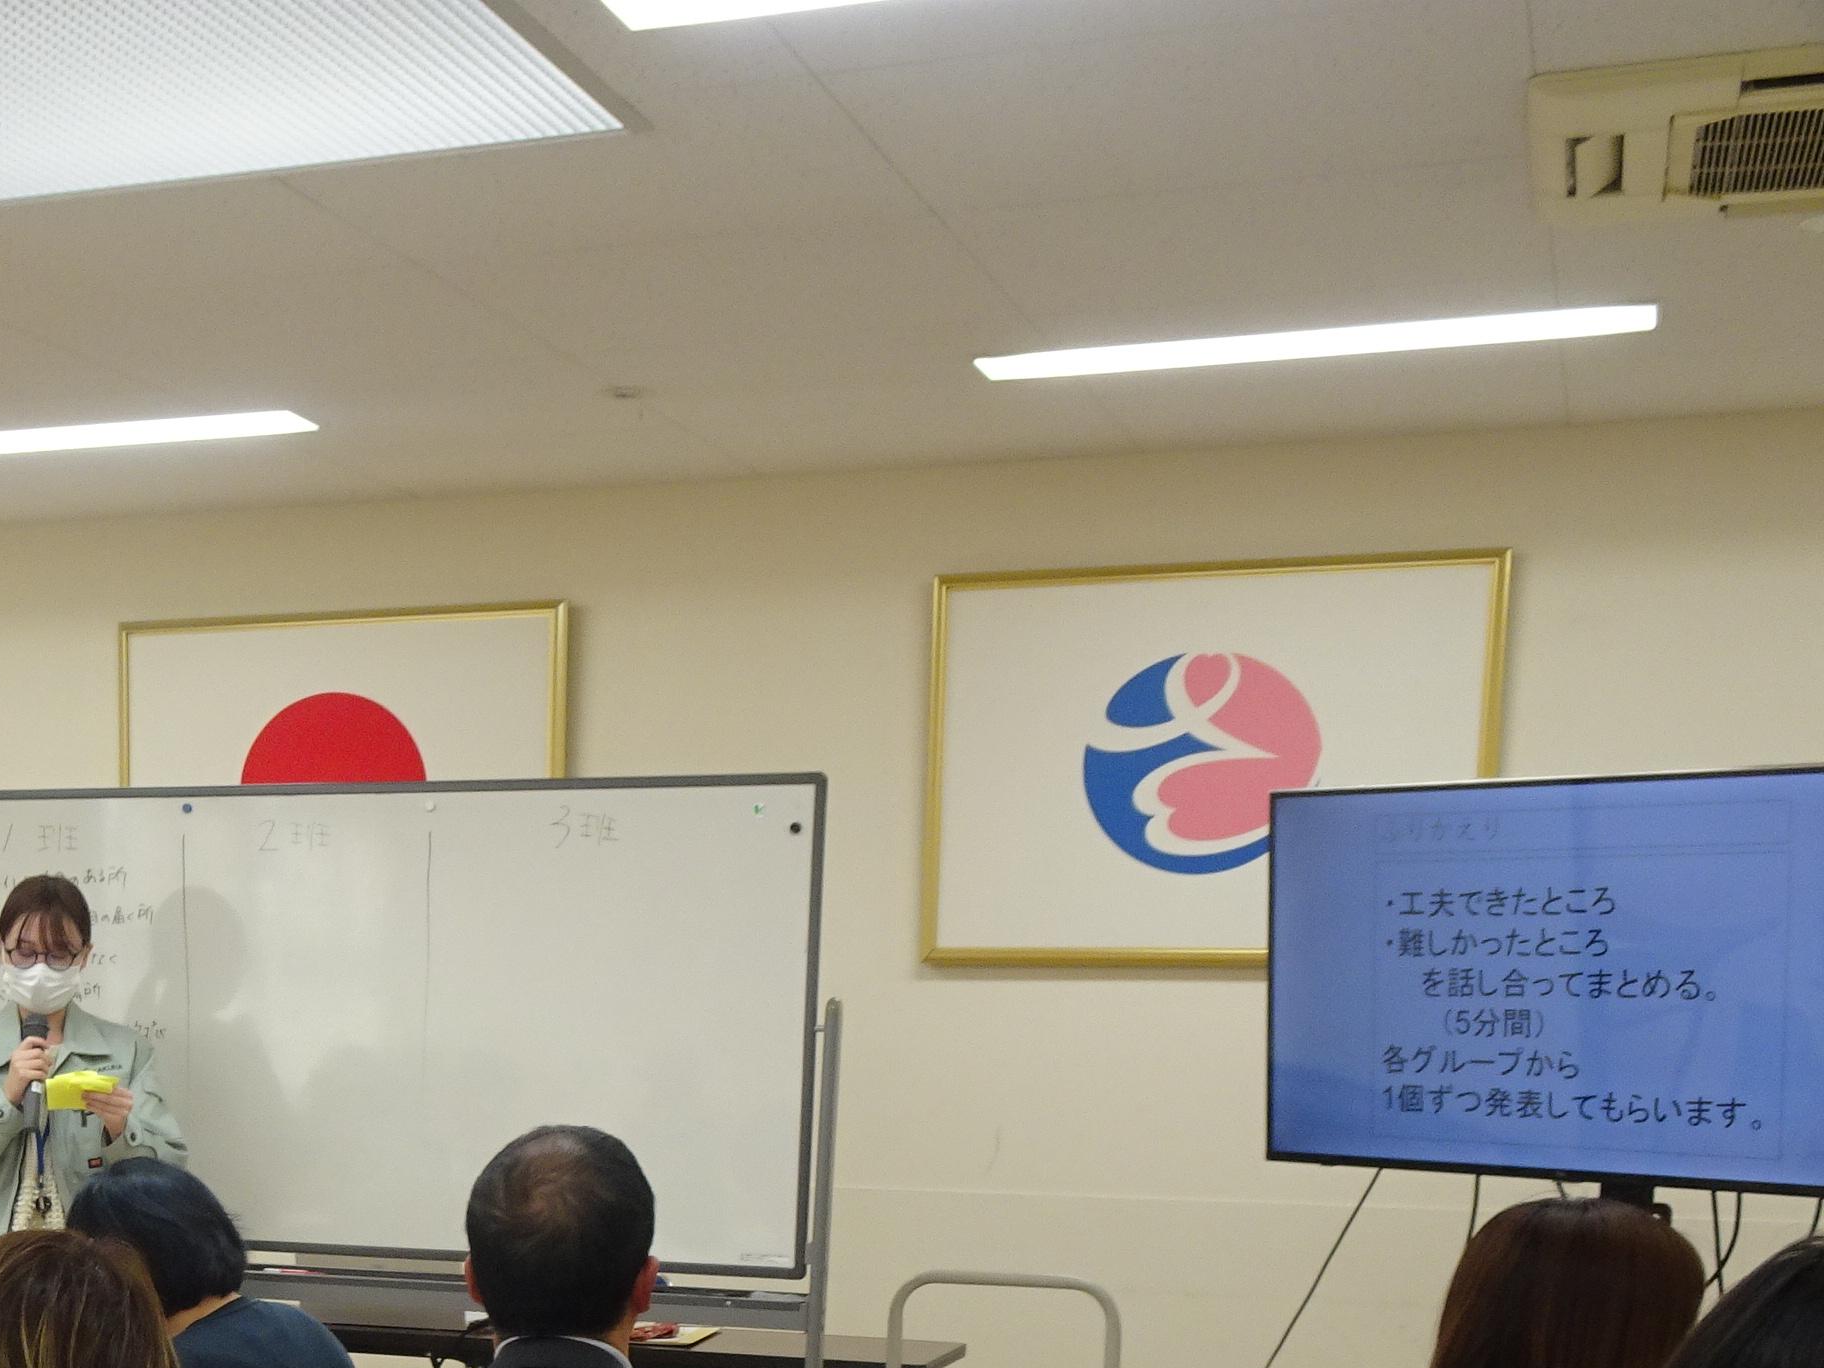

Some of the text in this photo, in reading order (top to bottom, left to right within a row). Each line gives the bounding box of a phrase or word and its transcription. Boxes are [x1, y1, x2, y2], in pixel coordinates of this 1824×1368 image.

[1422, 967, 1717, 1002] を話し合ってまとめる。
[1383, 1045, 1580, 1080] 各グループから
[1383, 1085, 1763, 1131] 1個ずつ発表してもらいます。
